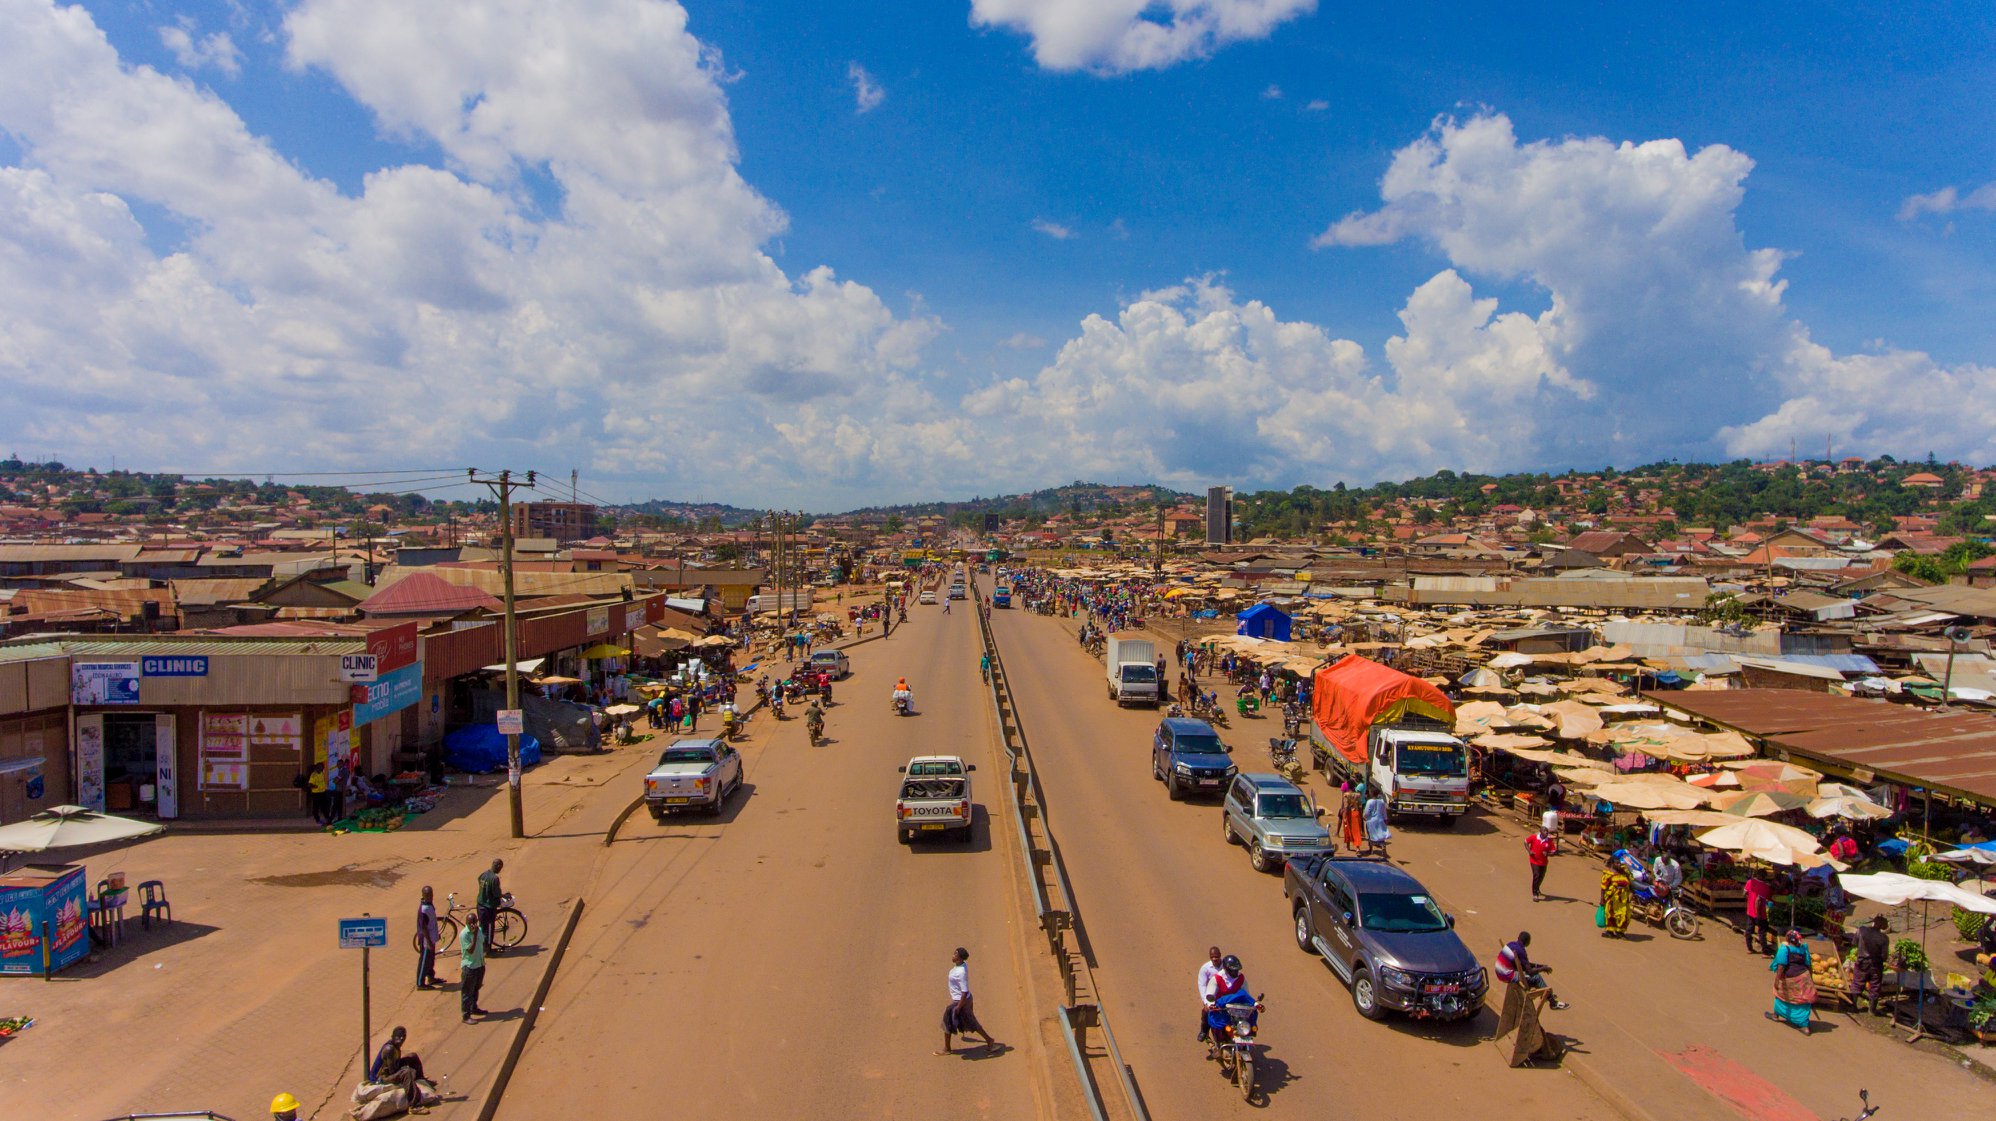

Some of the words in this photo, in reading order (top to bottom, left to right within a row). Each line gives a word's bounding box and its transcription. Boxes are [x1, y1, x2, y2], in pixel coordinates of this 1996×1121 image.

[144, 660, 205, 673] CLINIC
[343, 656, 375, 670] CLINIC
[368, 682, 389, 702] ECNO
[913, 807, 952, 815] TOYOTA
